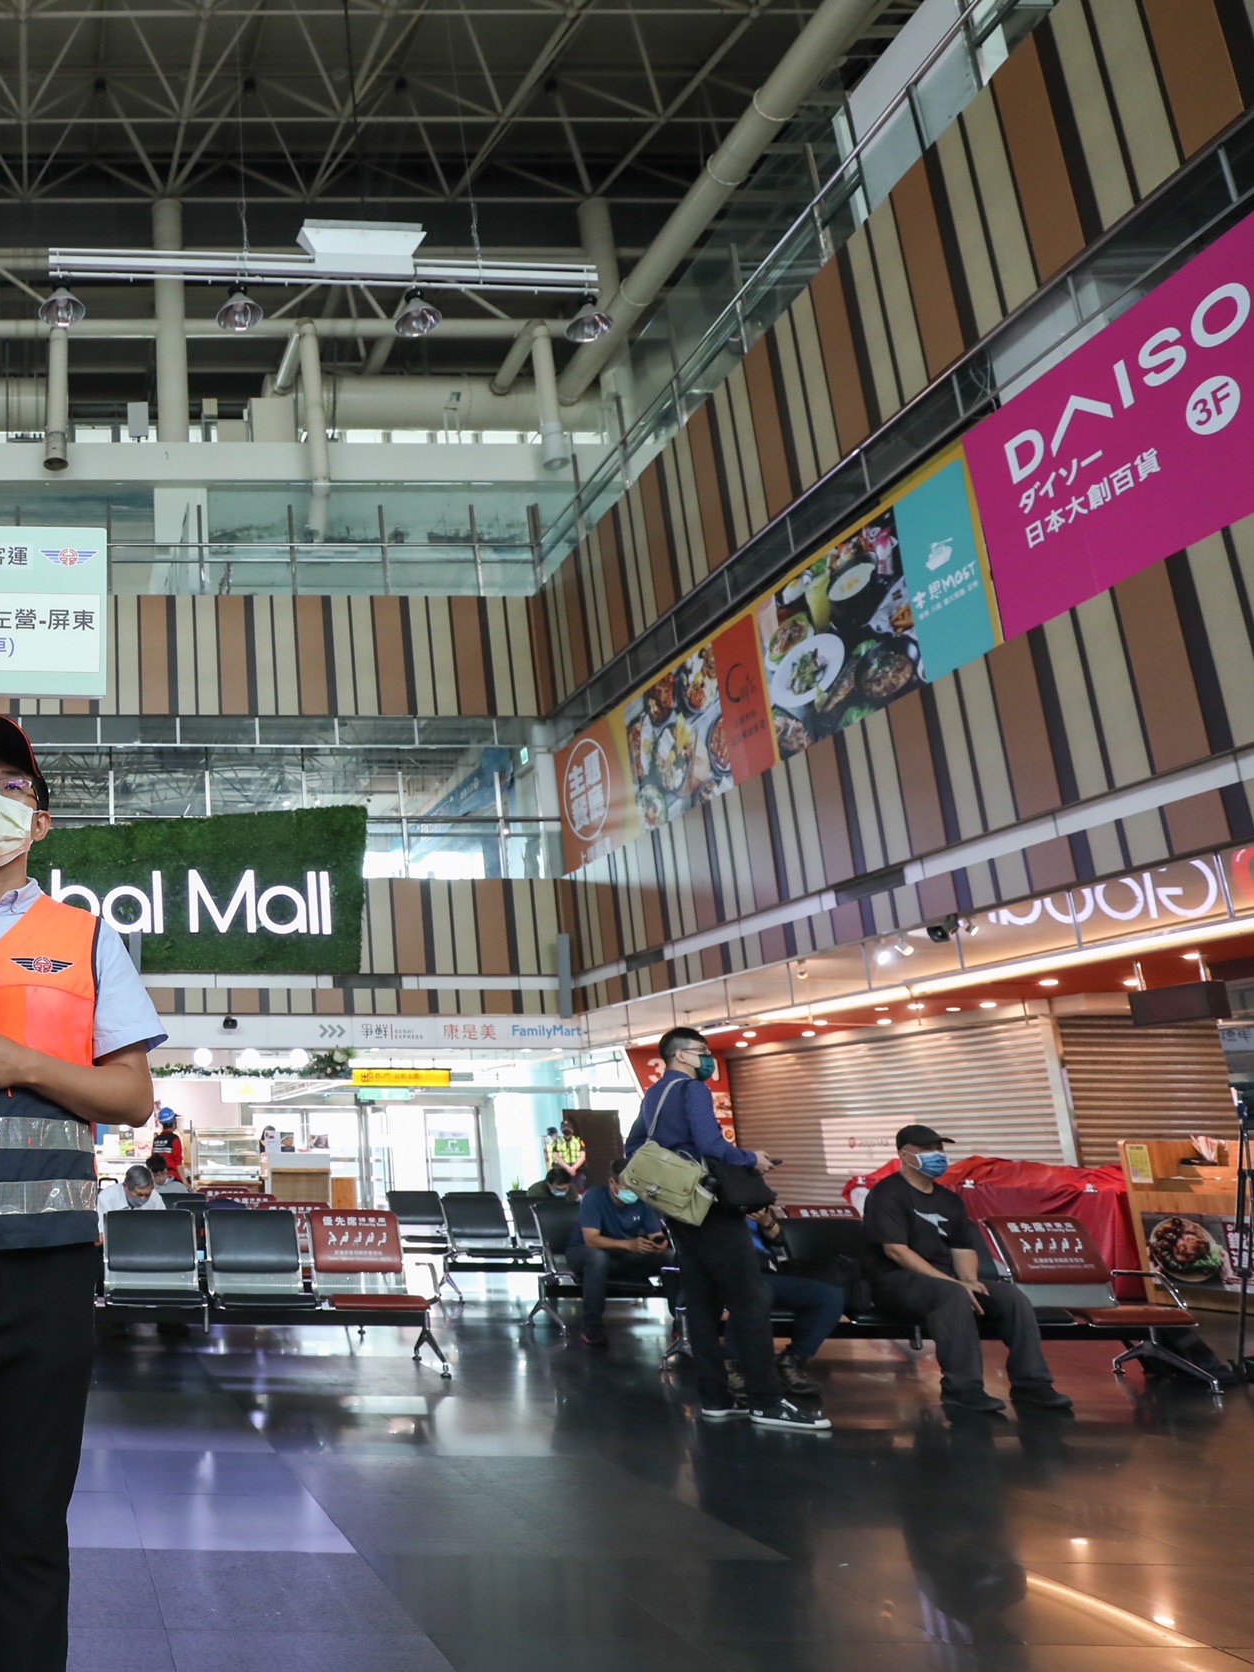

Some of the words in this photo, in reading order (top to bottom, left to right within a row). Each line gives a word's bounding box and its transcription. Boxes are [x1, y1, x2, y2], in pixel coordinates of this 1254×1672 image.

[1003, 282, 1251, 485] DAISO
[1192, 381, 1231, 427] 3F
[1019, 449, 1104, 514] ダイソー
[1025, 447, 1162, 549] 日本大創百貨
[188, 868, 333, 936] Mall
[443, 1023, 497, 1040] 康是美
[511, 1024, 582, 1040] FamilyMart
[322, 1216, 357, 1227] 優先席
[1007, 1222, 1045, 1233] 優先席
